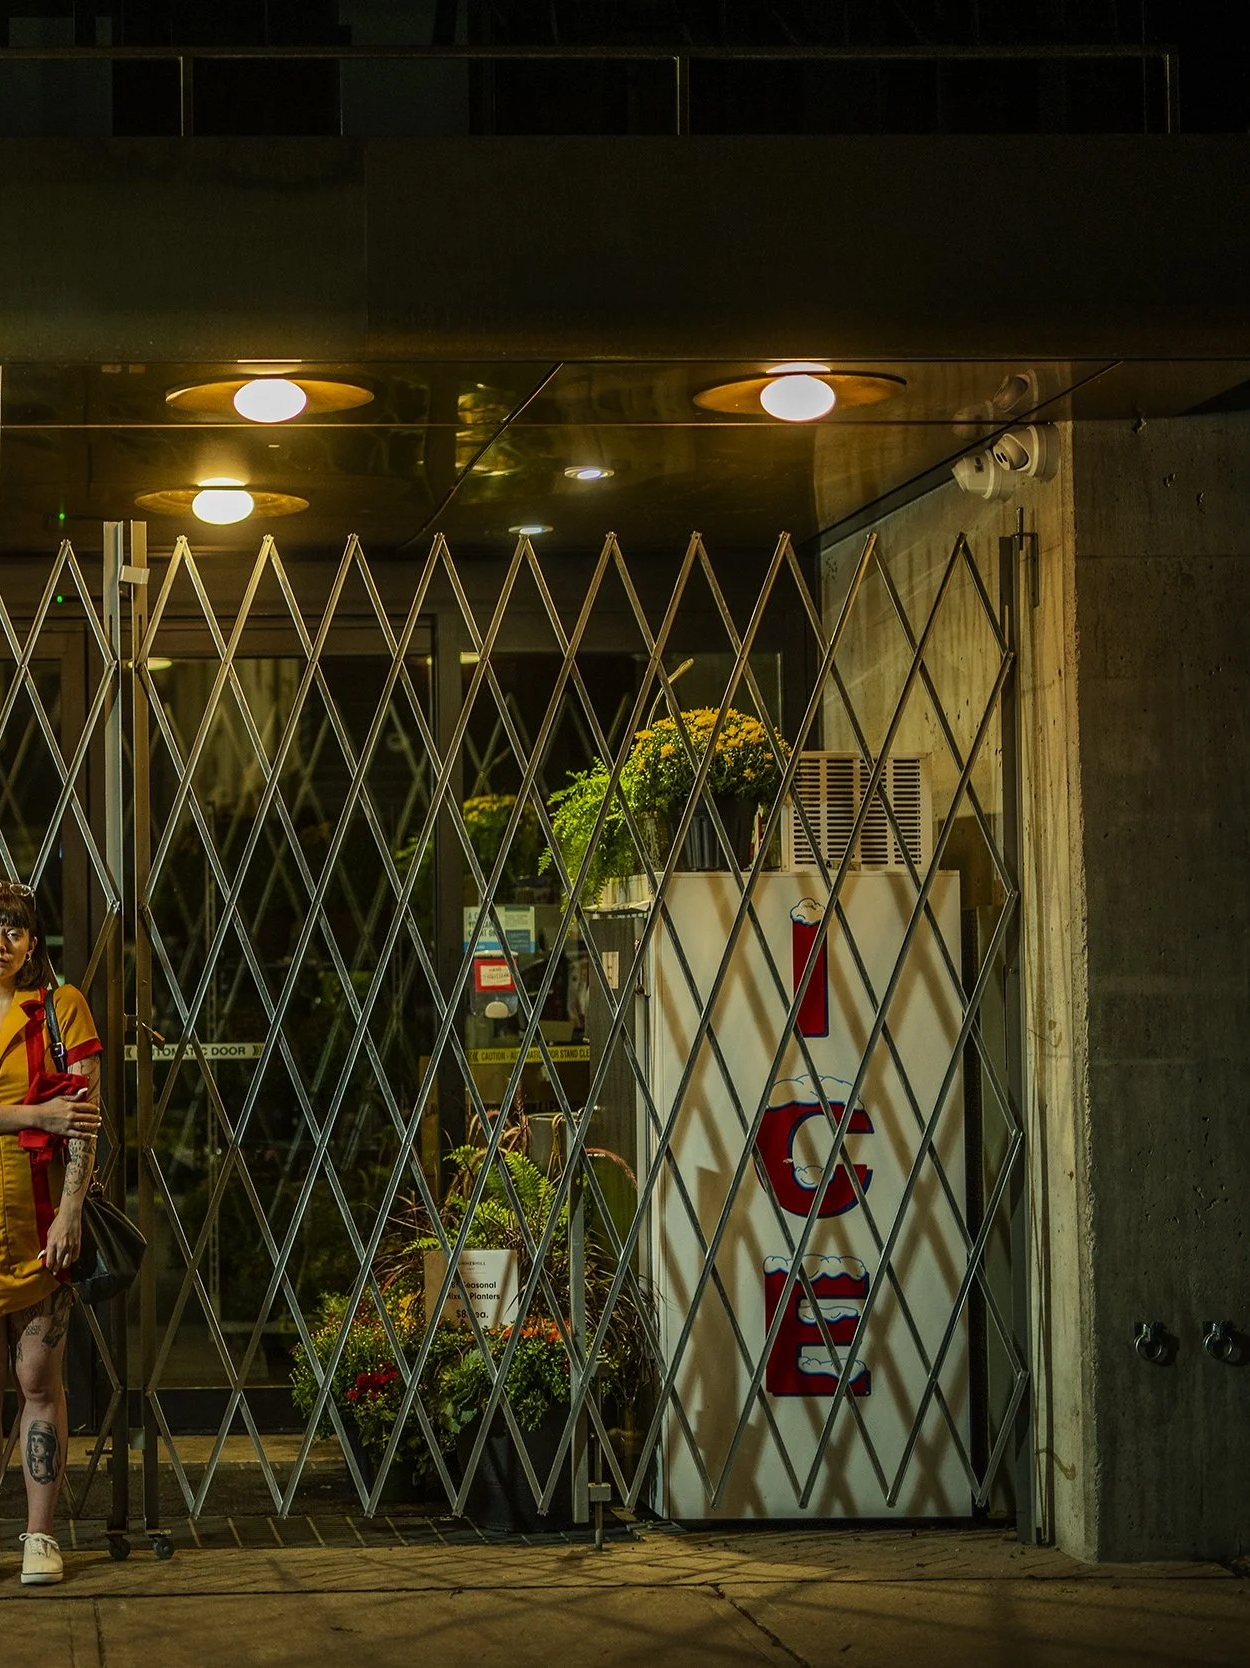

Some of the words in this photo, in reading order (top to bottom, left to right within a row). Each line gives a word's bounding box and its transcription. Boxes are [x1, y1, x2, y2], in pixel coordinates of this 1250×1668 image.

[212, 1046, 246, 1056] DOOR
[482, 1051, 505, 1060] CAUTION
[560, 1048, 578, 1058] STAND
[579, 1048, 590, 1057] CLE
[753, 897, 874, 1397] ICE
[470, 1292, 501, 1300] Planters
